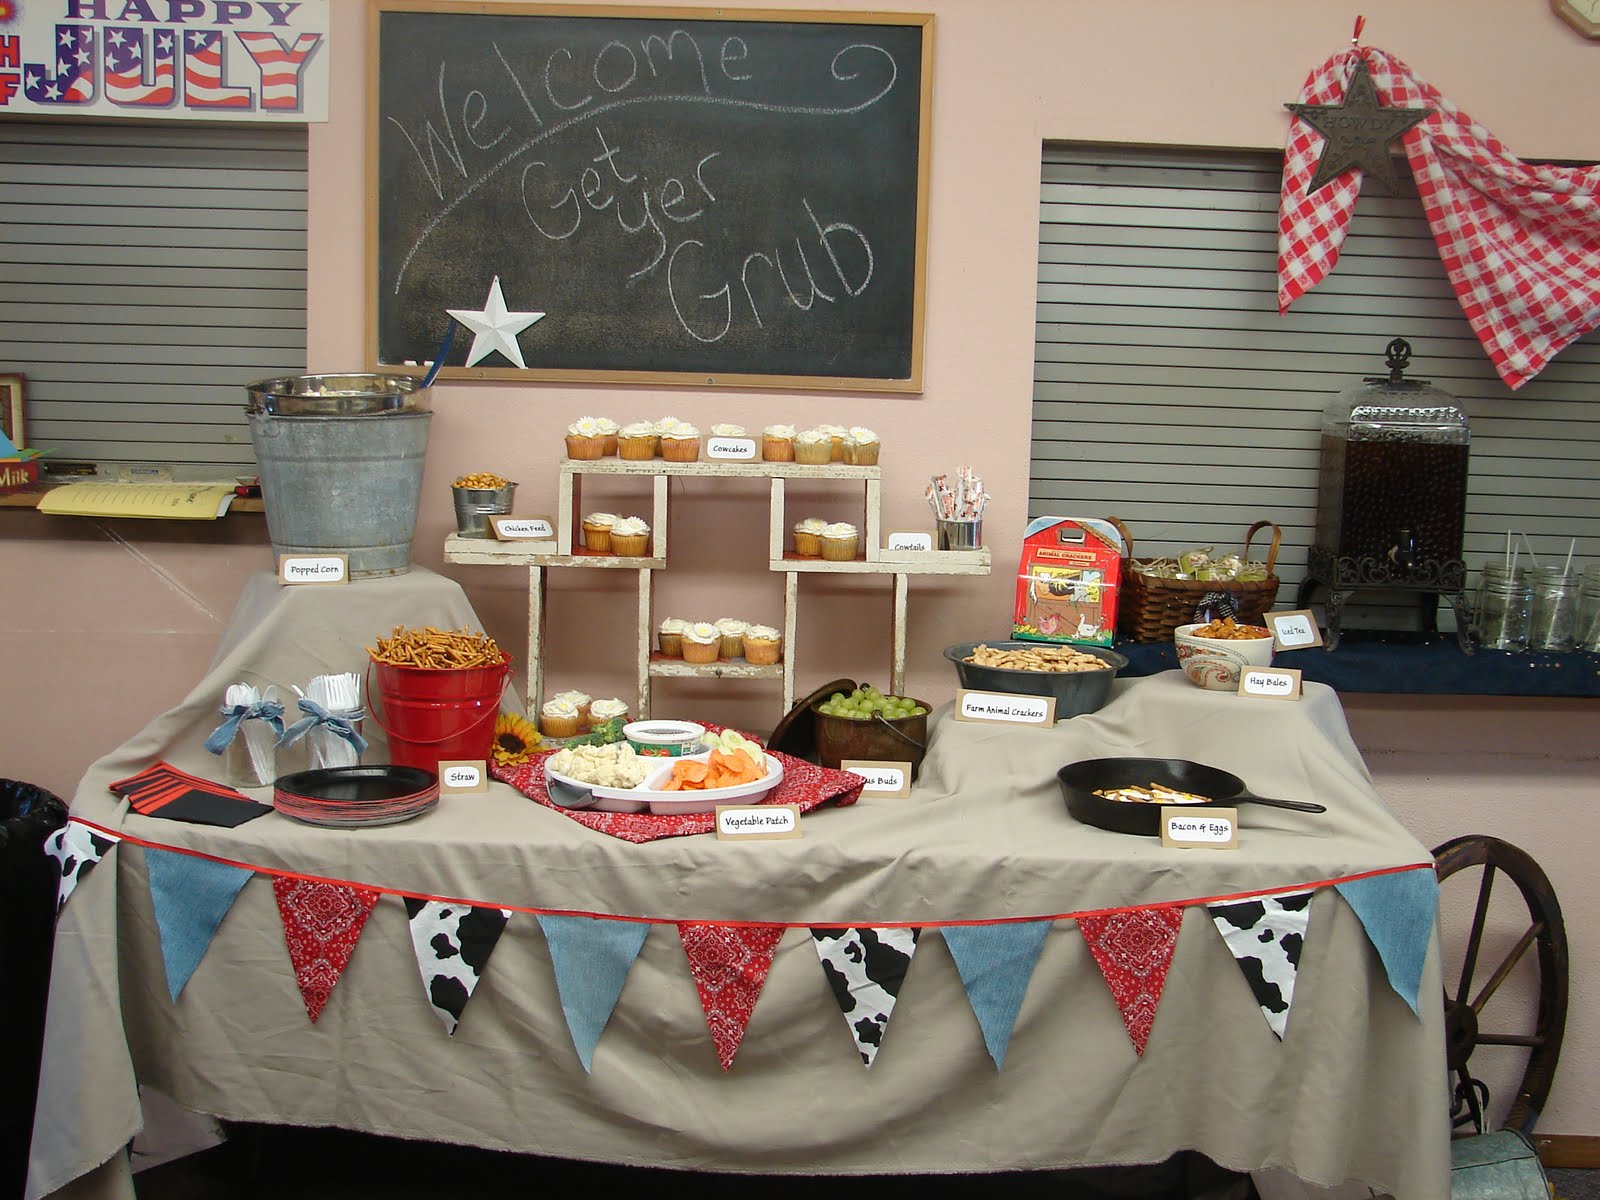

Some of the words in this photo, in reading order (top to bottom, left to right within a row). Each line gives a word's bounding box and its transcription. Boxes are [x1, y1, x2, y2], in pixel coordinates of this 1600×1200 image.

[64, 0, 301, 26] HAPPY
[24, 24, 323, 111] JULY
[387, 29, 753, 200] Welcome
[1322, 115, 1396, 130] HOWDY
[521, 127, 637, 240] Get
[616, 152, 720, 287] yer
[667, 198, 874, 342] Grub
[712, 444, 749, 453] Cowcakes
[0, 466, 29, 488] Milk
[504, 524, 529, 532] Chicken
[529, 523, 547, 532] Feed
[894, 542, 926, 551] Cowtails
[1061, 552, 1093, 561] CRACKERS
[291, 563, 319, 576] Popped
[320, 566, 340, 574] Corn
[1281, 625, 1295, 635] Iced
[1293, 627, 1306, 635] Tea
[1250, 676, 1265, 688] Hay
[1266, 677, 1288, 687] Bales
[965, 703, 985, 713] Farm
[986, 705, 1011, 715] Animal
[1011, 707, 1044, 718] Crackers
[450, 772, 476, 782] Straw
[877, 774, 898, 785] Buds
[724, 814, 764, 830] Vegetable
[765, 815, 789, 825] Patch
[1171, 821, 1197, 831] Bacon
[1209, 823, 1229, 836] Eggs
